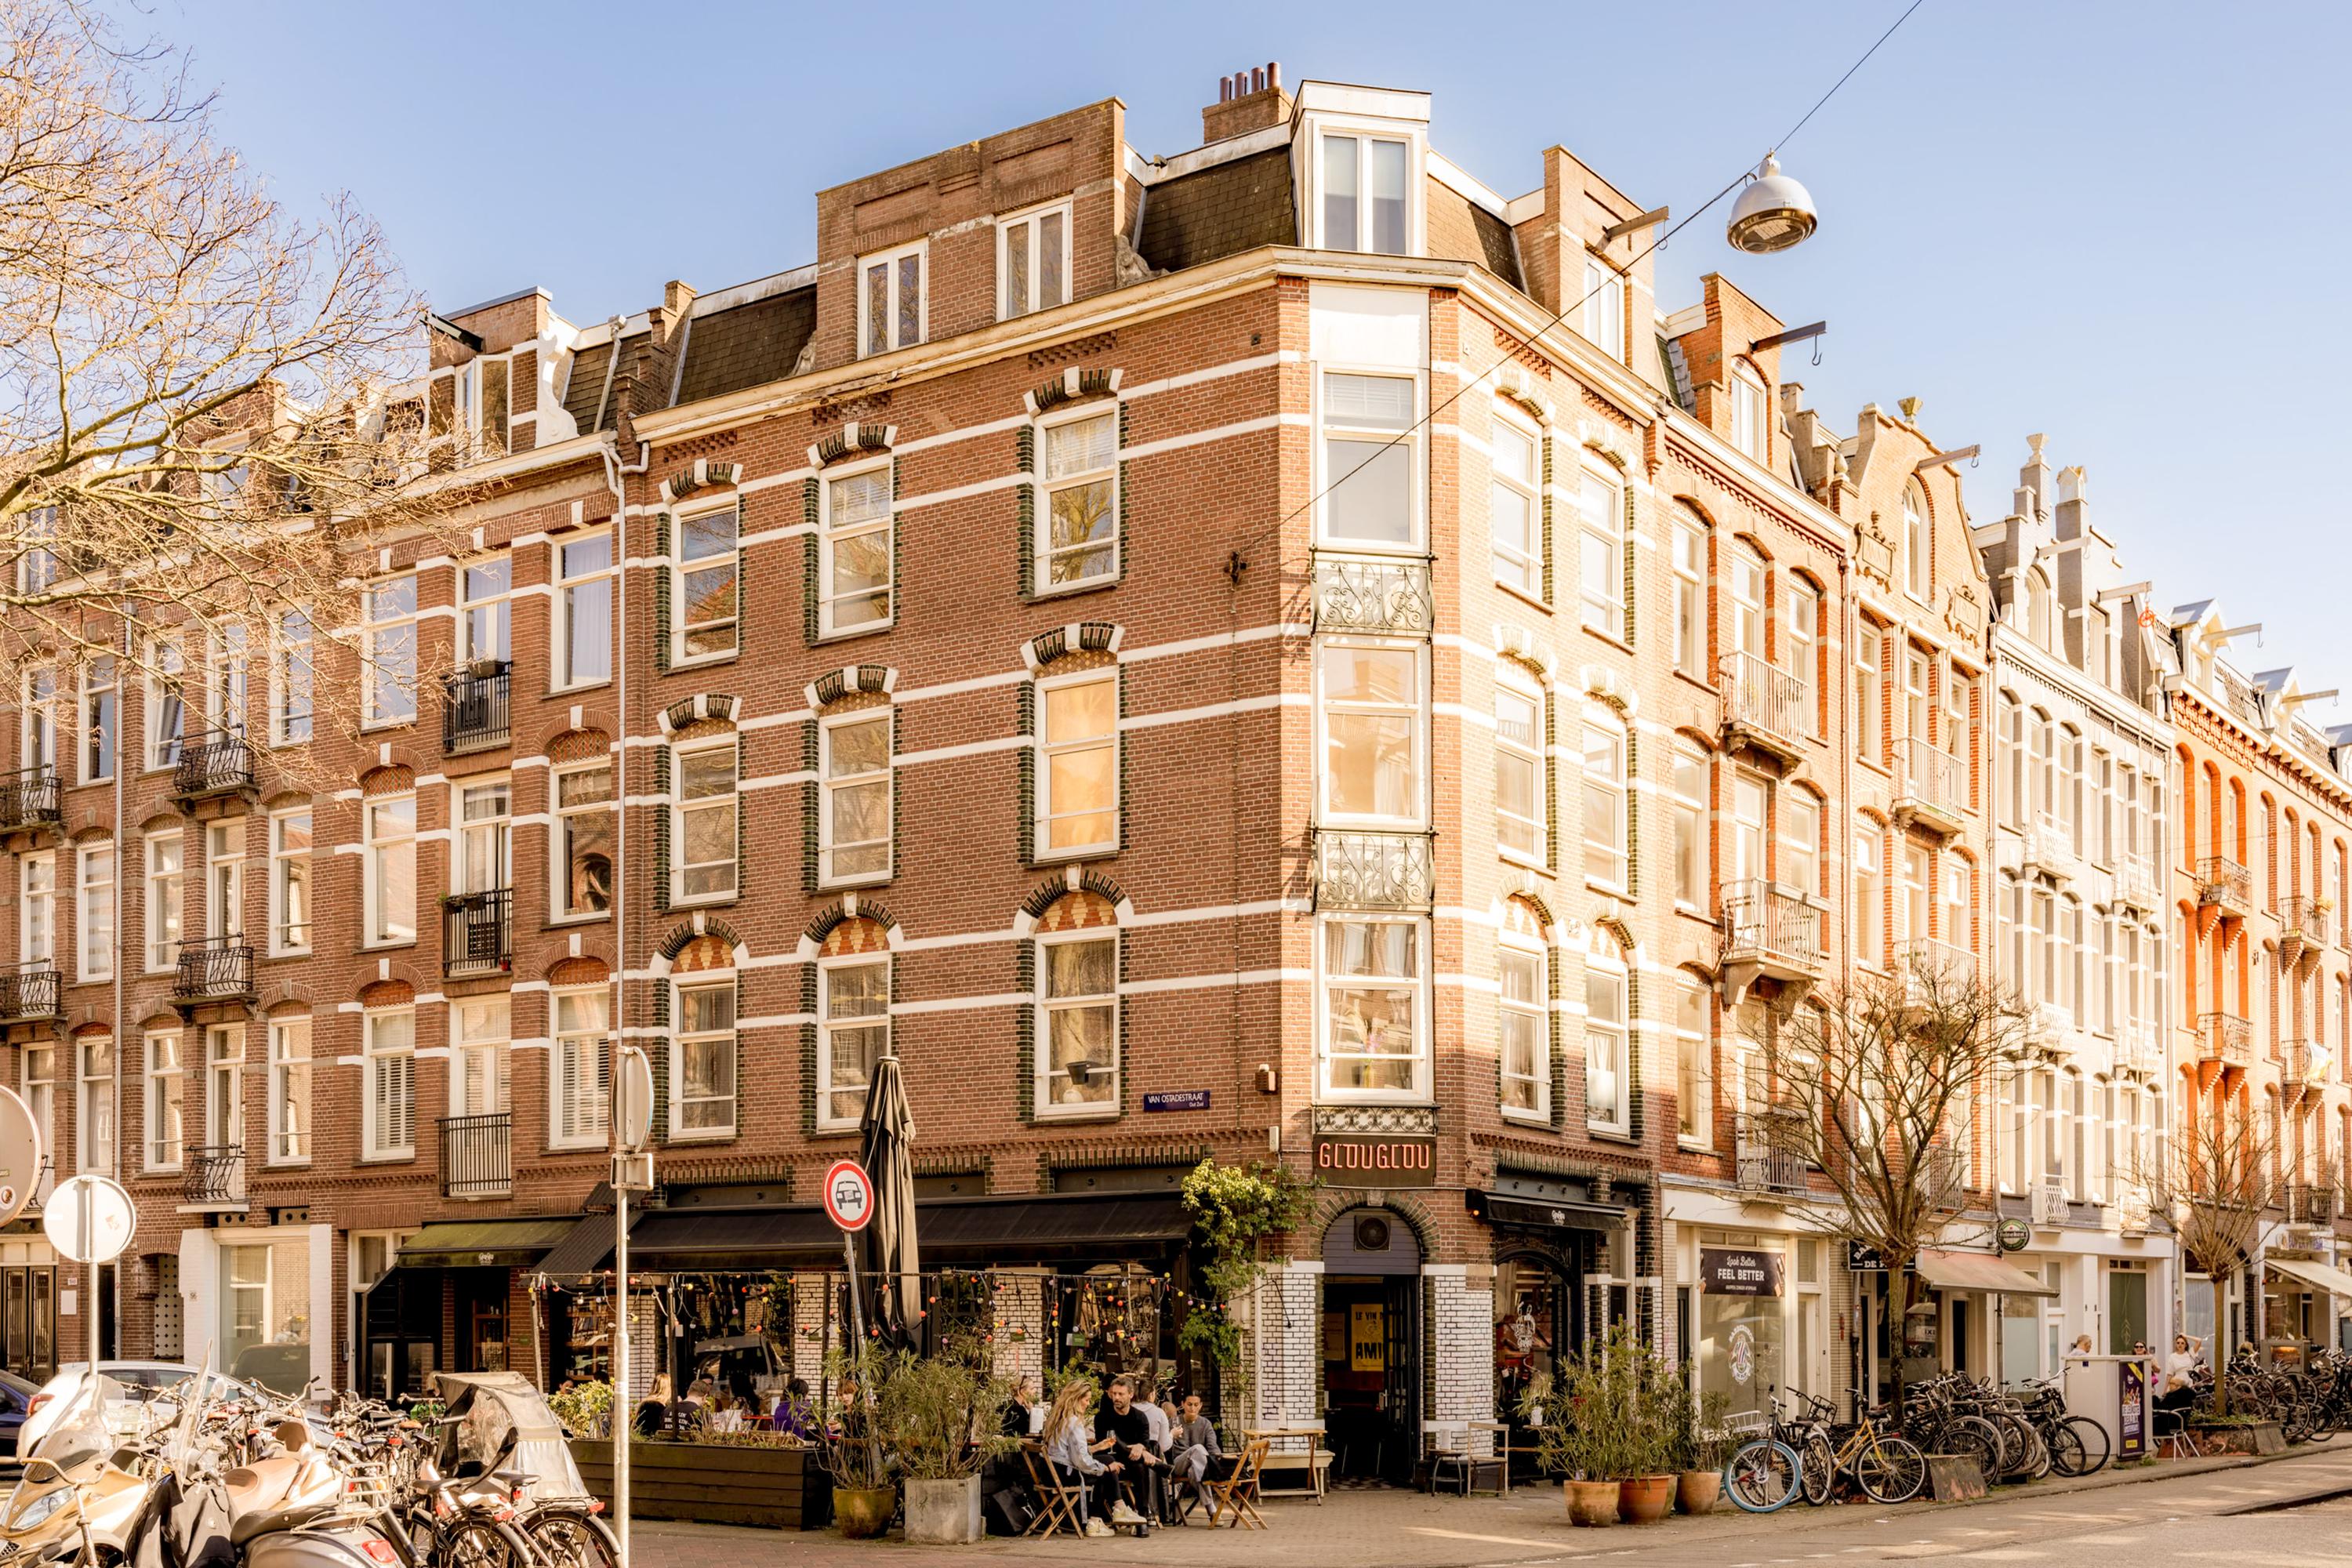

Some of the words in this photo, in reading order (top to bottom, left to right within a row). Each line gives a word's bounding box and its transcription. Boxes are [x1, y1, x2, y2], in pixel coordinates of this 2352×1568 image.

[1161, 1093, 1203, 1103] OSTADESTRAAT
[1319, 1143, 1429, 1169] GLOUGLOU
[1727, 1255, 1740, 1267] Look
[1740, 1255, 1756, 1267] Better
[1718, 1269, 1735, 1279] FEEL
[1737, 1269, 1765, 1281] BETTER
[1356, 1312, 1363, 1320] LE
[1365, 1312, 1377, 1320] VIN
[1356, 1342, 1382, 1359] AMI
